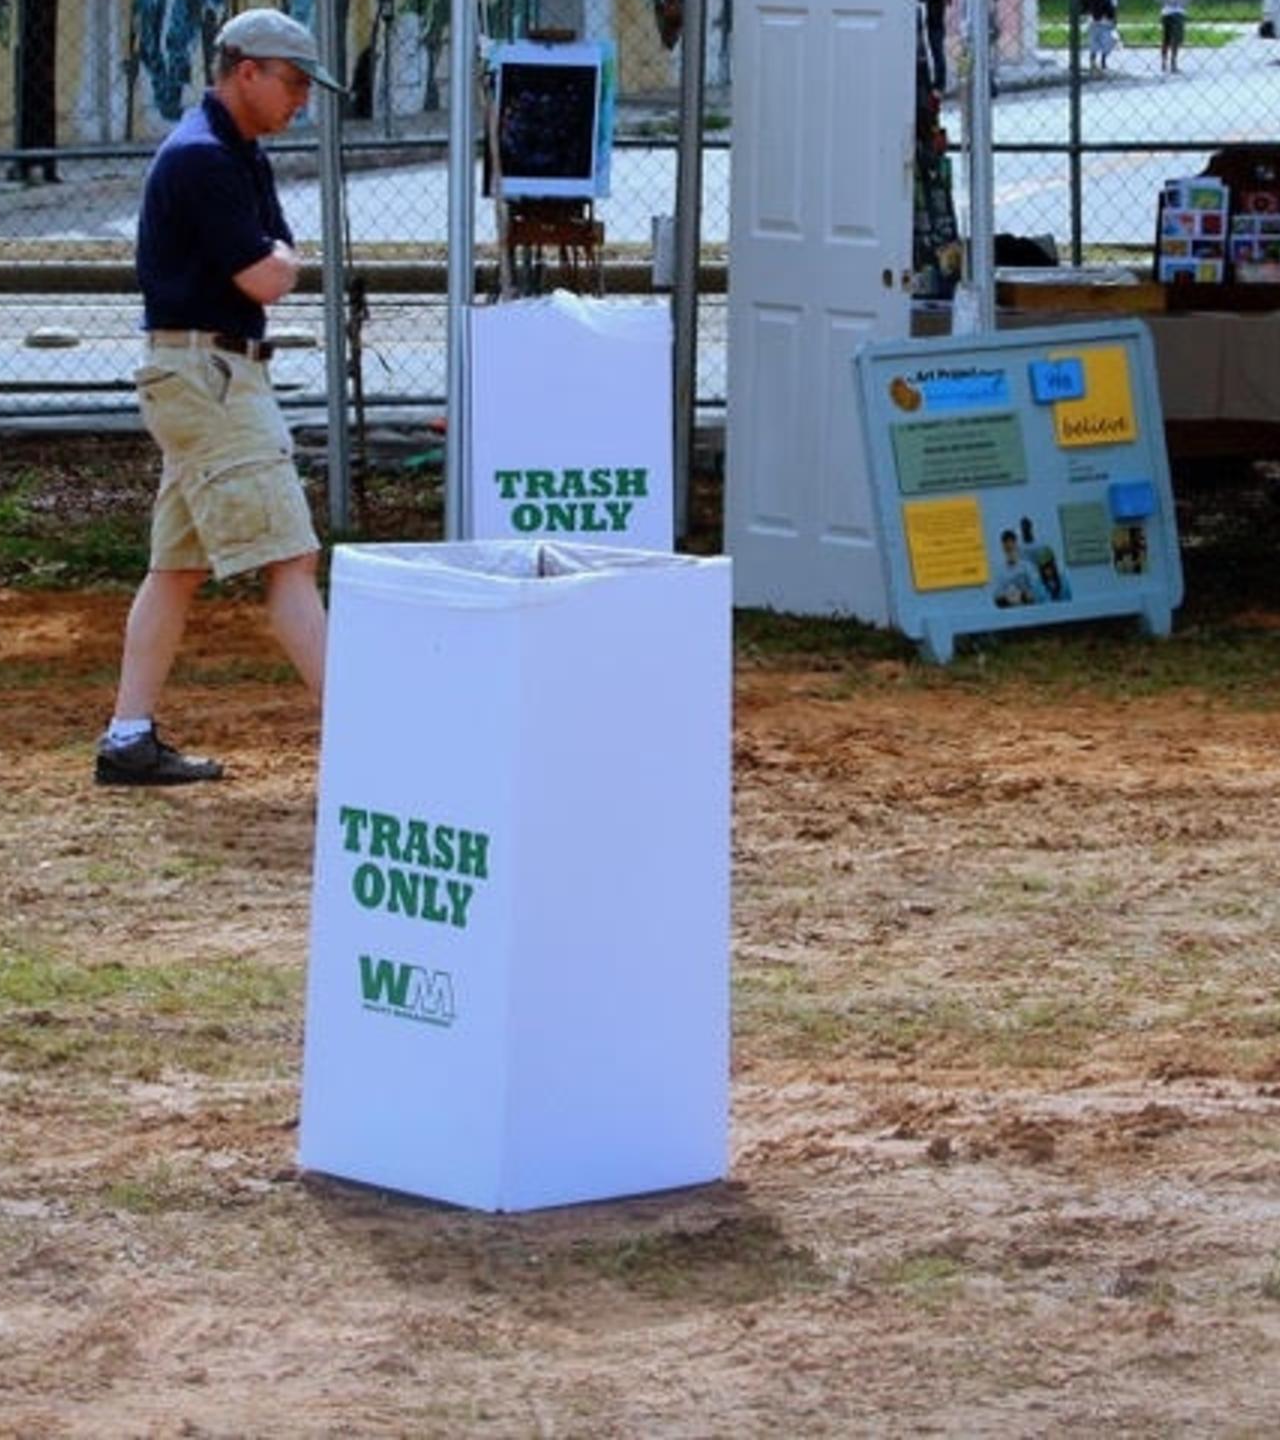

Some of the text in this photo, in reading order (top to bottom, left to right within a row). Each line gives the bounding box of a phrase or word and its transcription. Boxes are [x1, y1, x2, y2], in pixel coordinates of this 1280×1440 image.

[1062, 416, 1127, 438] believe
[495, 469, 649, 499] TRASH
[512, 502, 634, 532] ONLY
[340, 806, 489, 879] TRASH
[352, 862, 473, 929] ONLY
[359, 955, 456, 1018] WM
